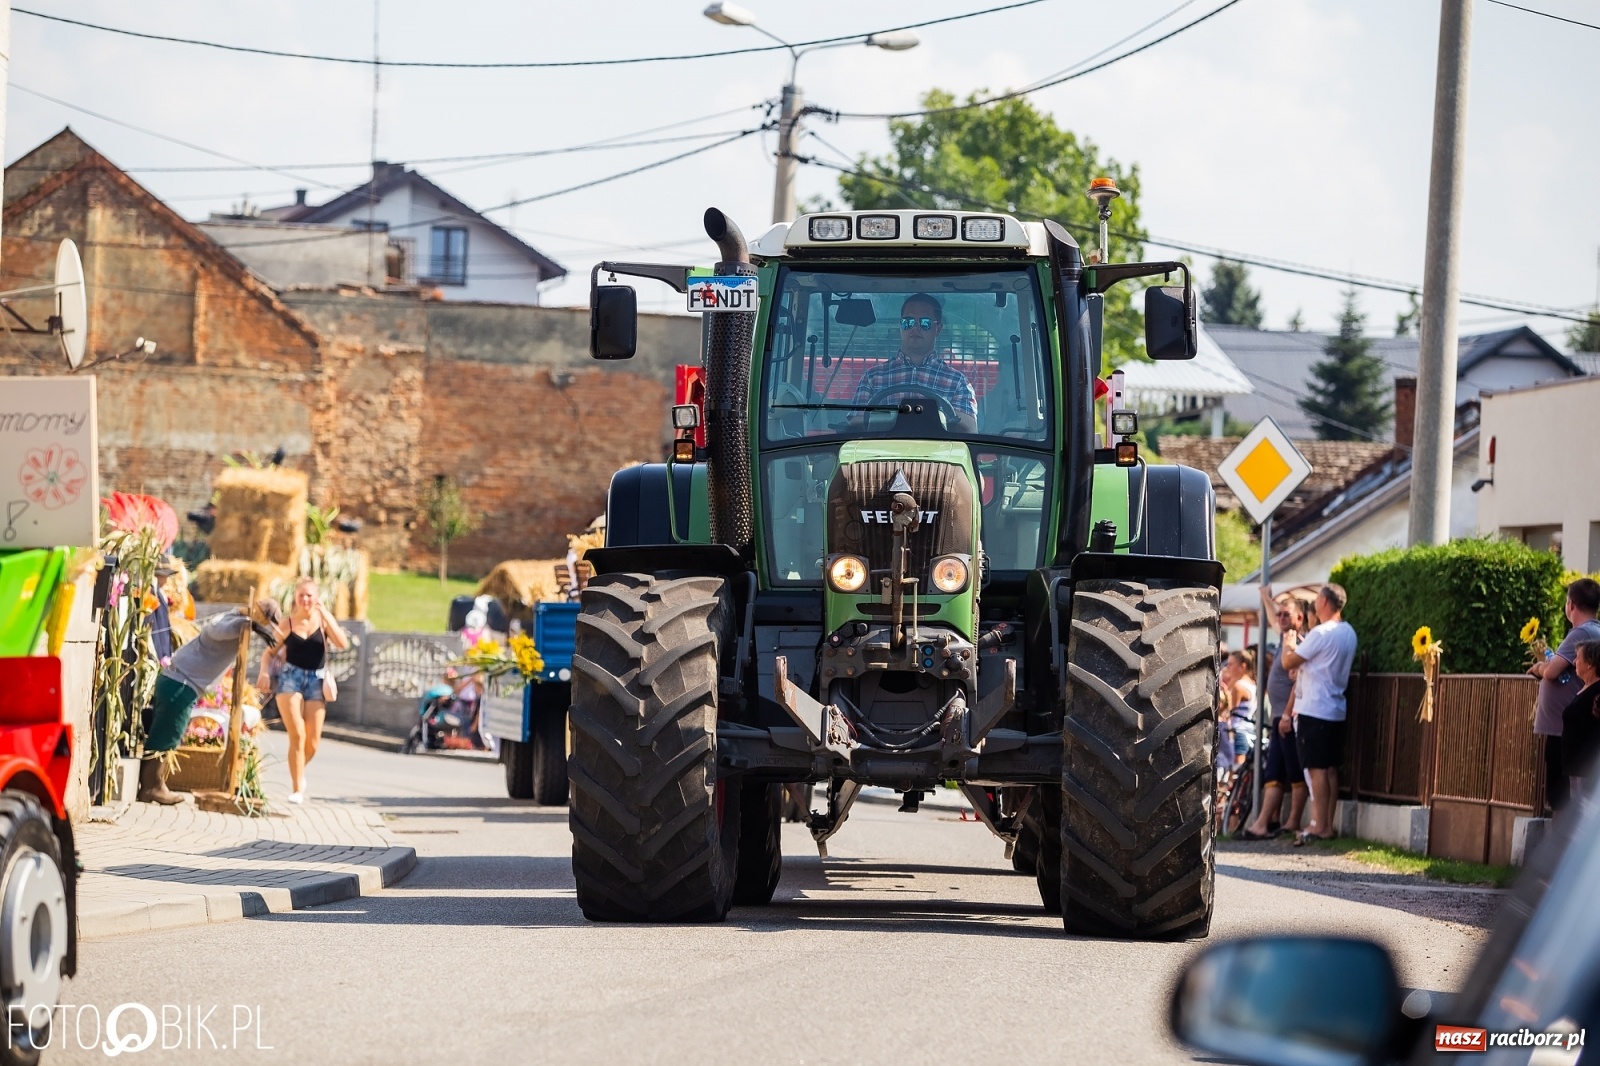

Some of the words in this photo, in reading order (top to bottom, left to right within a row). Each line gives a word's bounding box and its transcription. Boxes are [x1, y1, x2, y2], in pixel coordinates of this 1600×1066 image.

[713, 278, 752, 287] Wyoming
[690, 289, 755, 308] FENDT
[860, 510, 939, 524] FET
